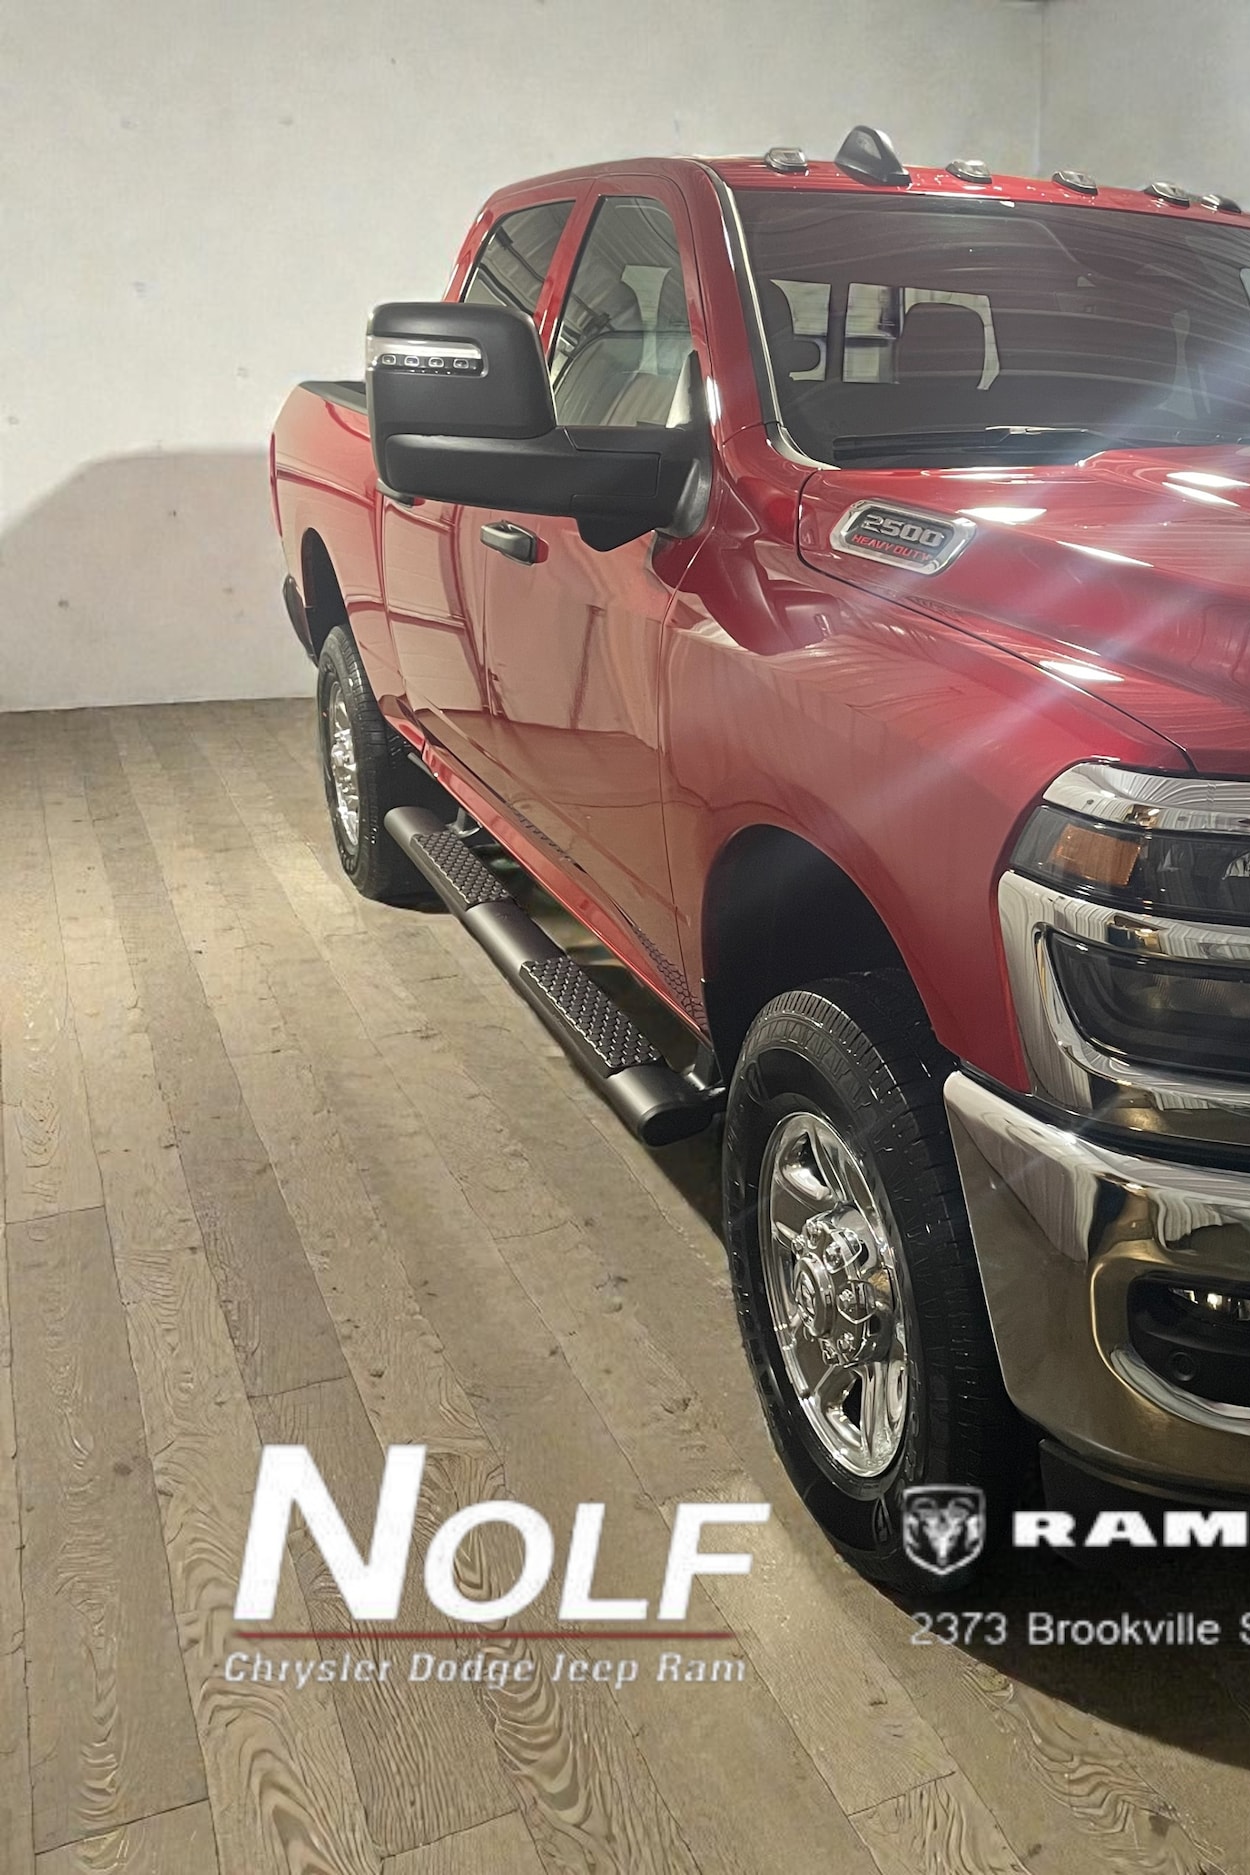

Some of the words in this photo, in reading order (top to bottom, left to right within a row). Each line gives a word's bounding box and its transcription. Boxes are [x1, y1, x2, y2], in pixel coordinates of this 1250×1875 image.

[860, 514, 945, 547] 2500
[851, 534, 893, 551] HEAVY
[894, 545, 934, 561] DUTY
